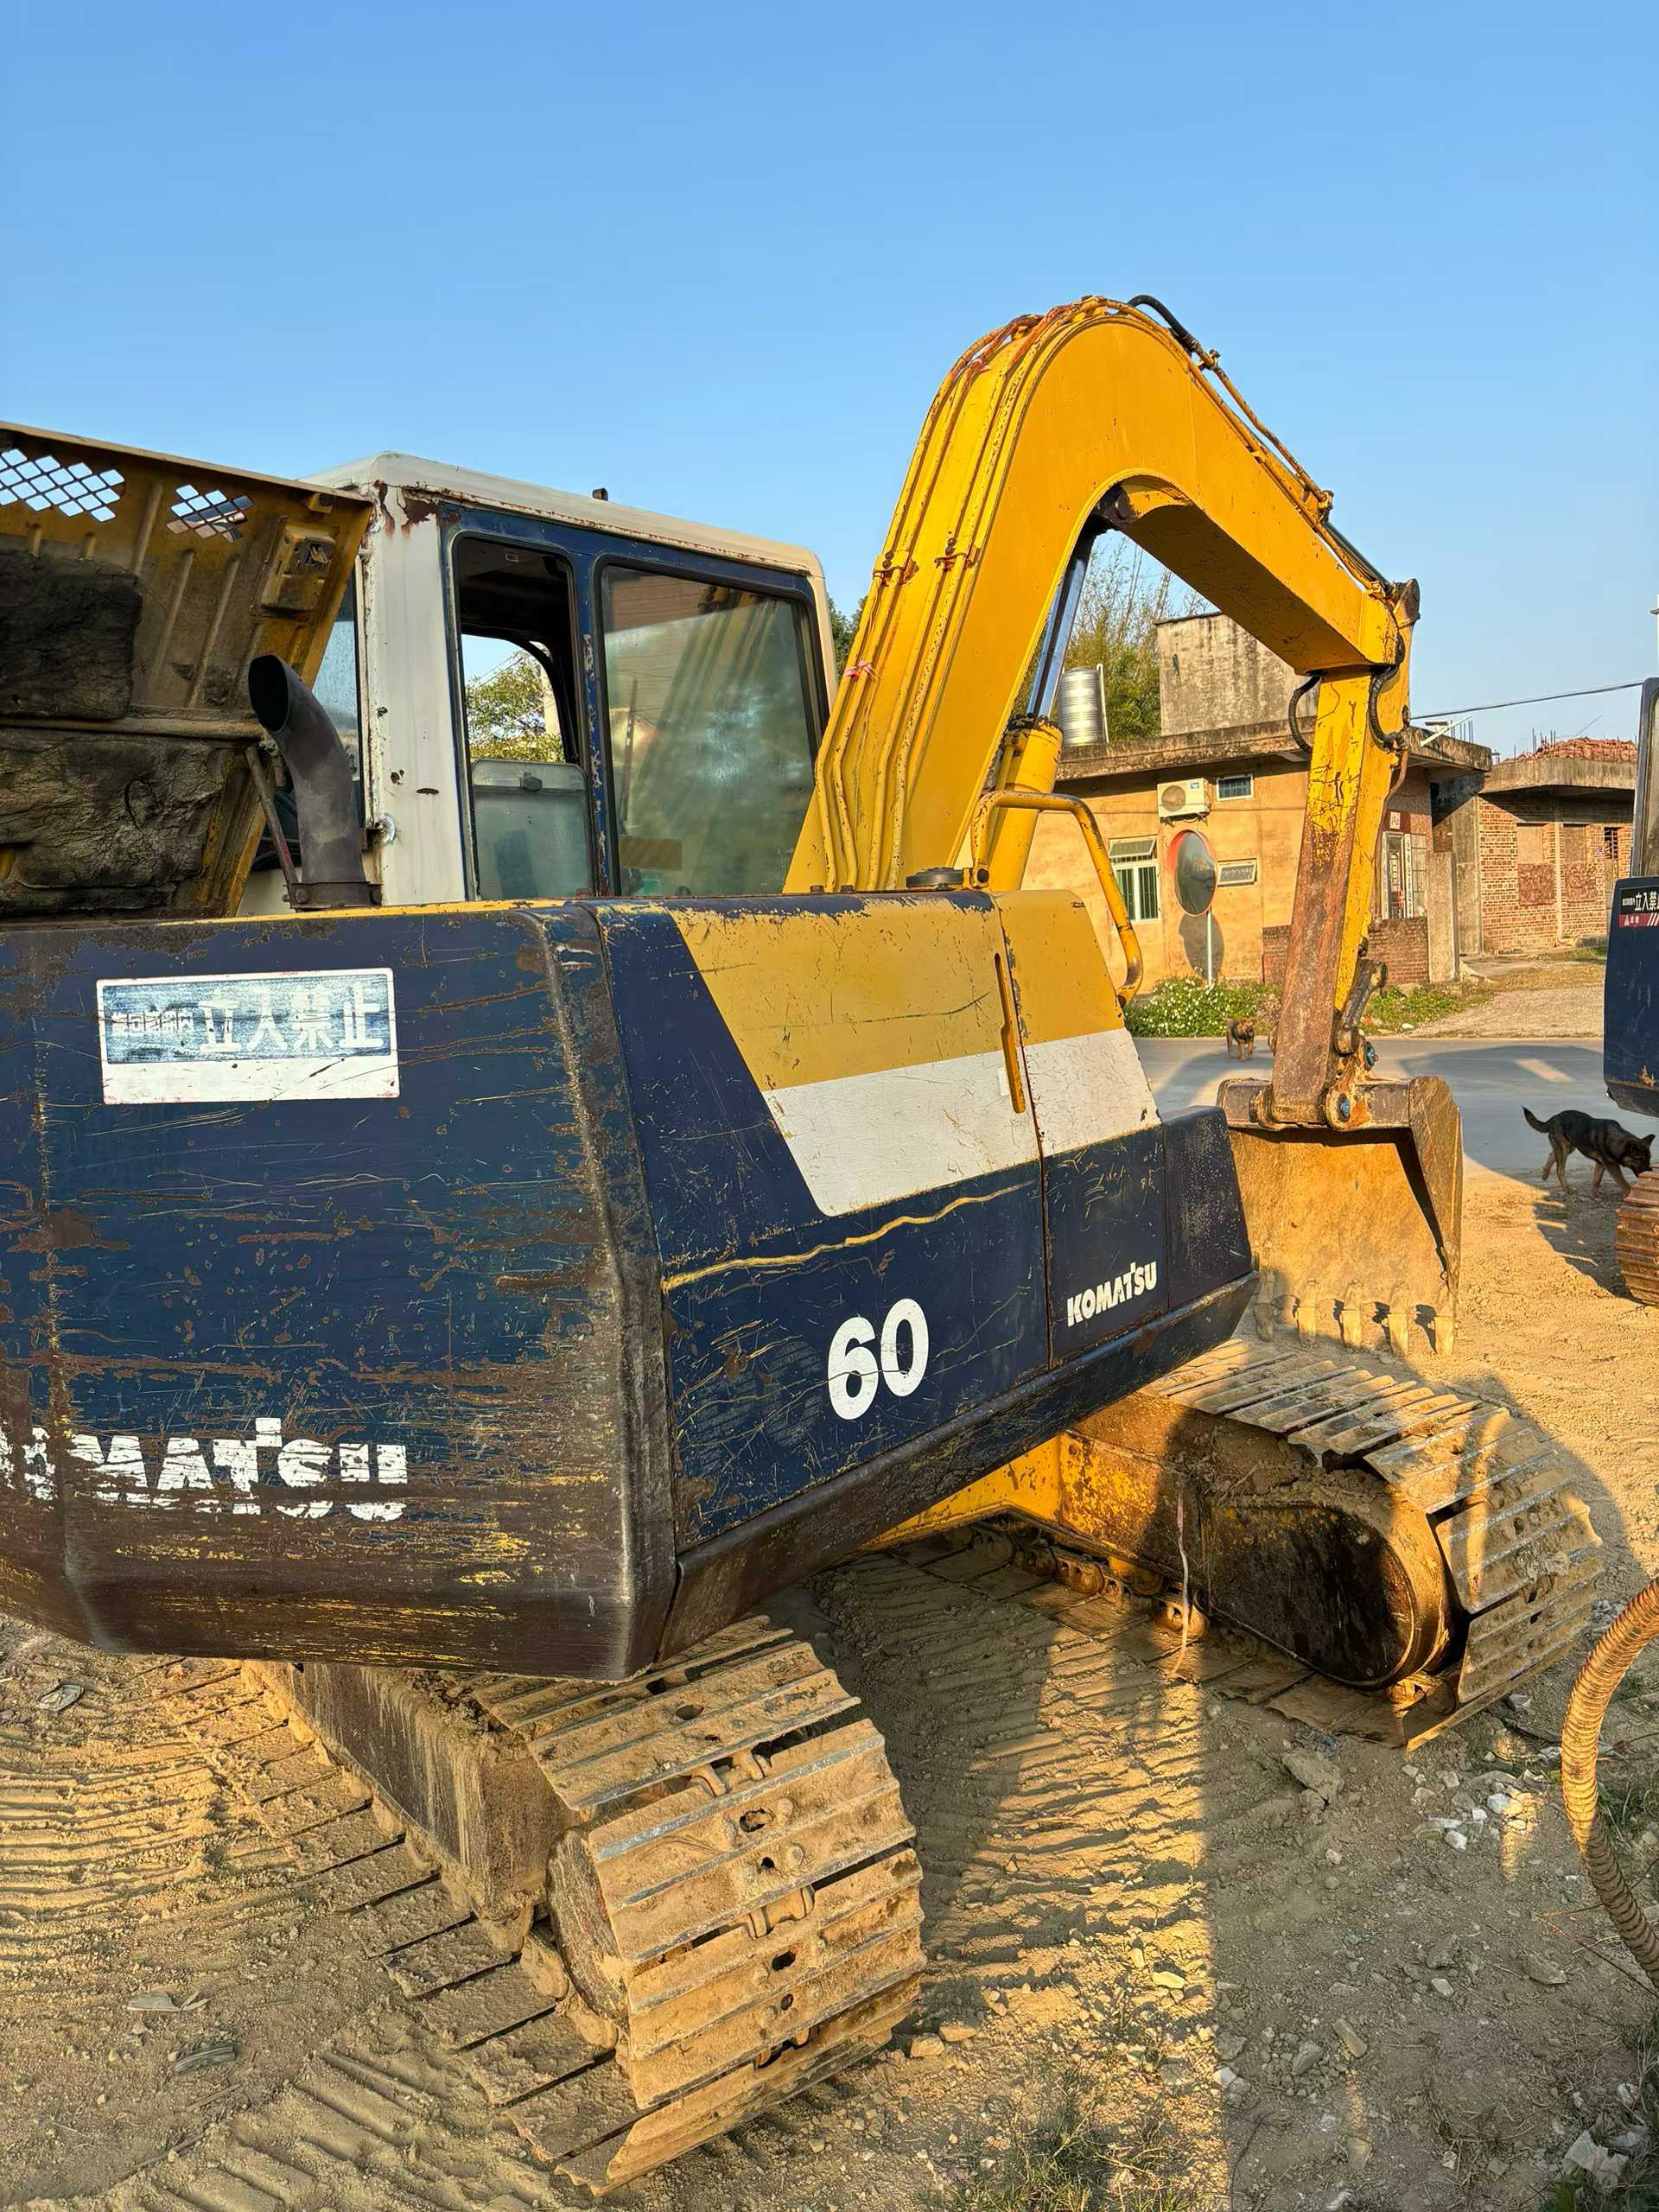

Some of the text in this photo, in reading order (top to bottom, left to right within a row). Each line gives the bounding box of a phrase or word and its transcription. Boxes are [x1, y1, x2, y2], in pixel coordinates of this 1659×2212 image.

[1635, 891, 1659, 912] 立入禁
[1067, 1262, 1157, 1327] KOMATSU
[828, 1298, 929, 1420] 60
